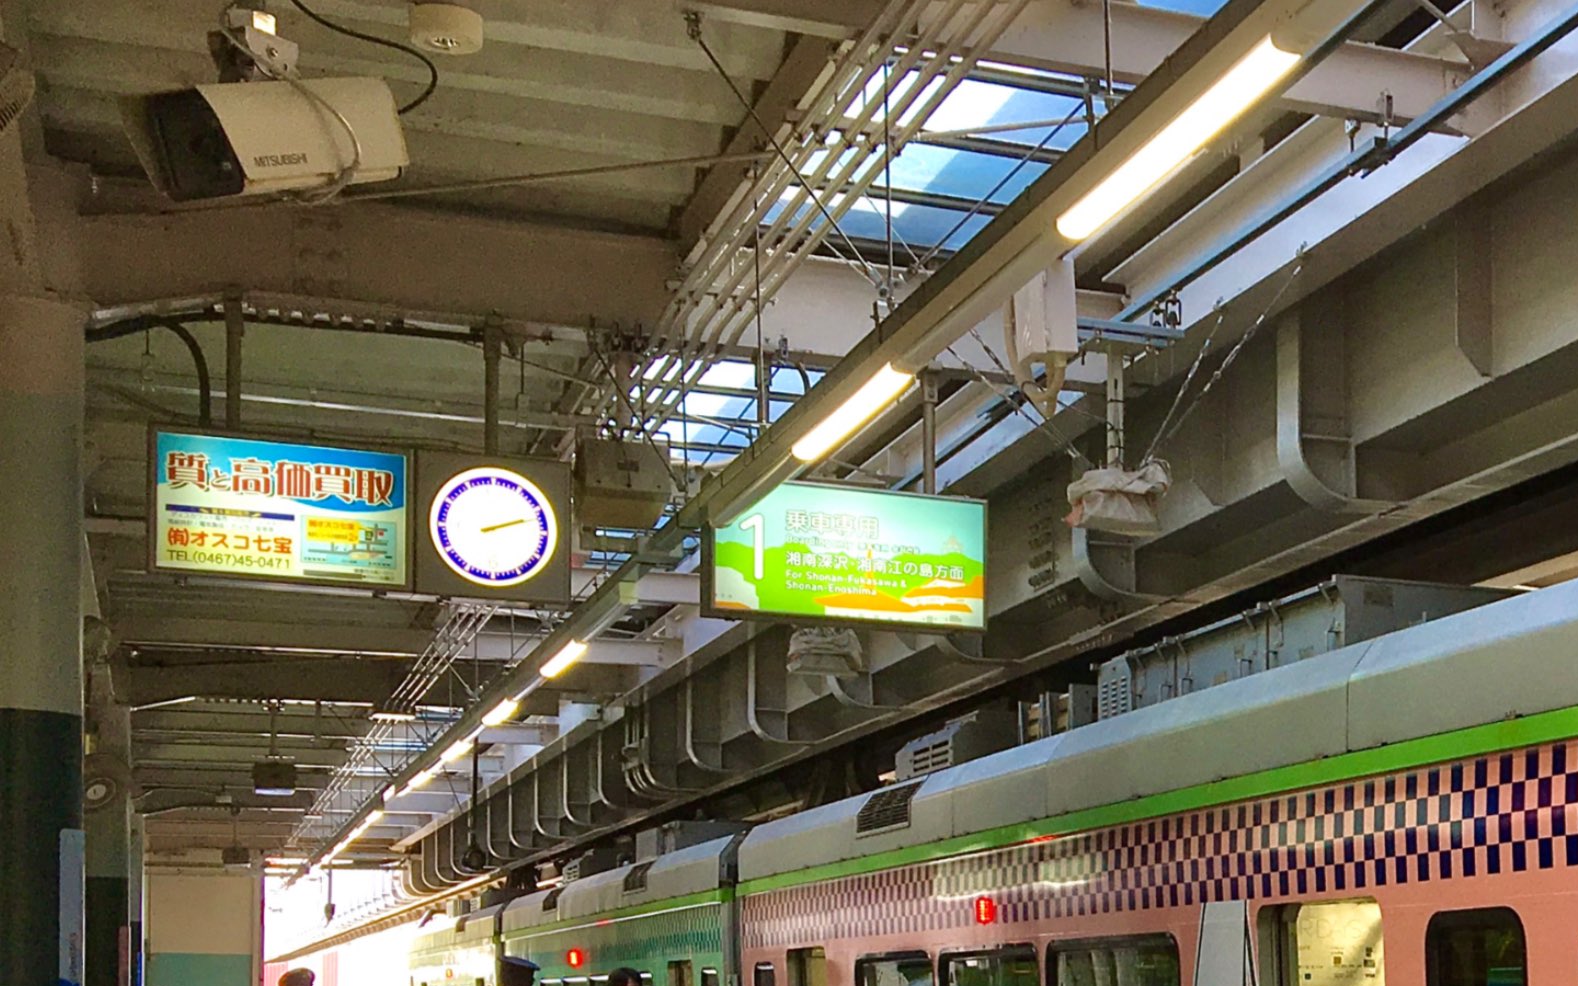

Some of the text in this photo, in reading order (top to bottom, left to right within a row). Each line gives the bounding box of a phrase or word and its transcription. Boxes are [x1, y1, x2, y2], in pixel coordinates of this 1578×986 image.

[253, 153, 308, 167] MITSUBISHI
[165, 451, 393, 506] 質と高価買取
[785, 510, 879, 539] 乗車専用
[740, 513, 765, 580] 1
[786, 570, 801, 580] For
